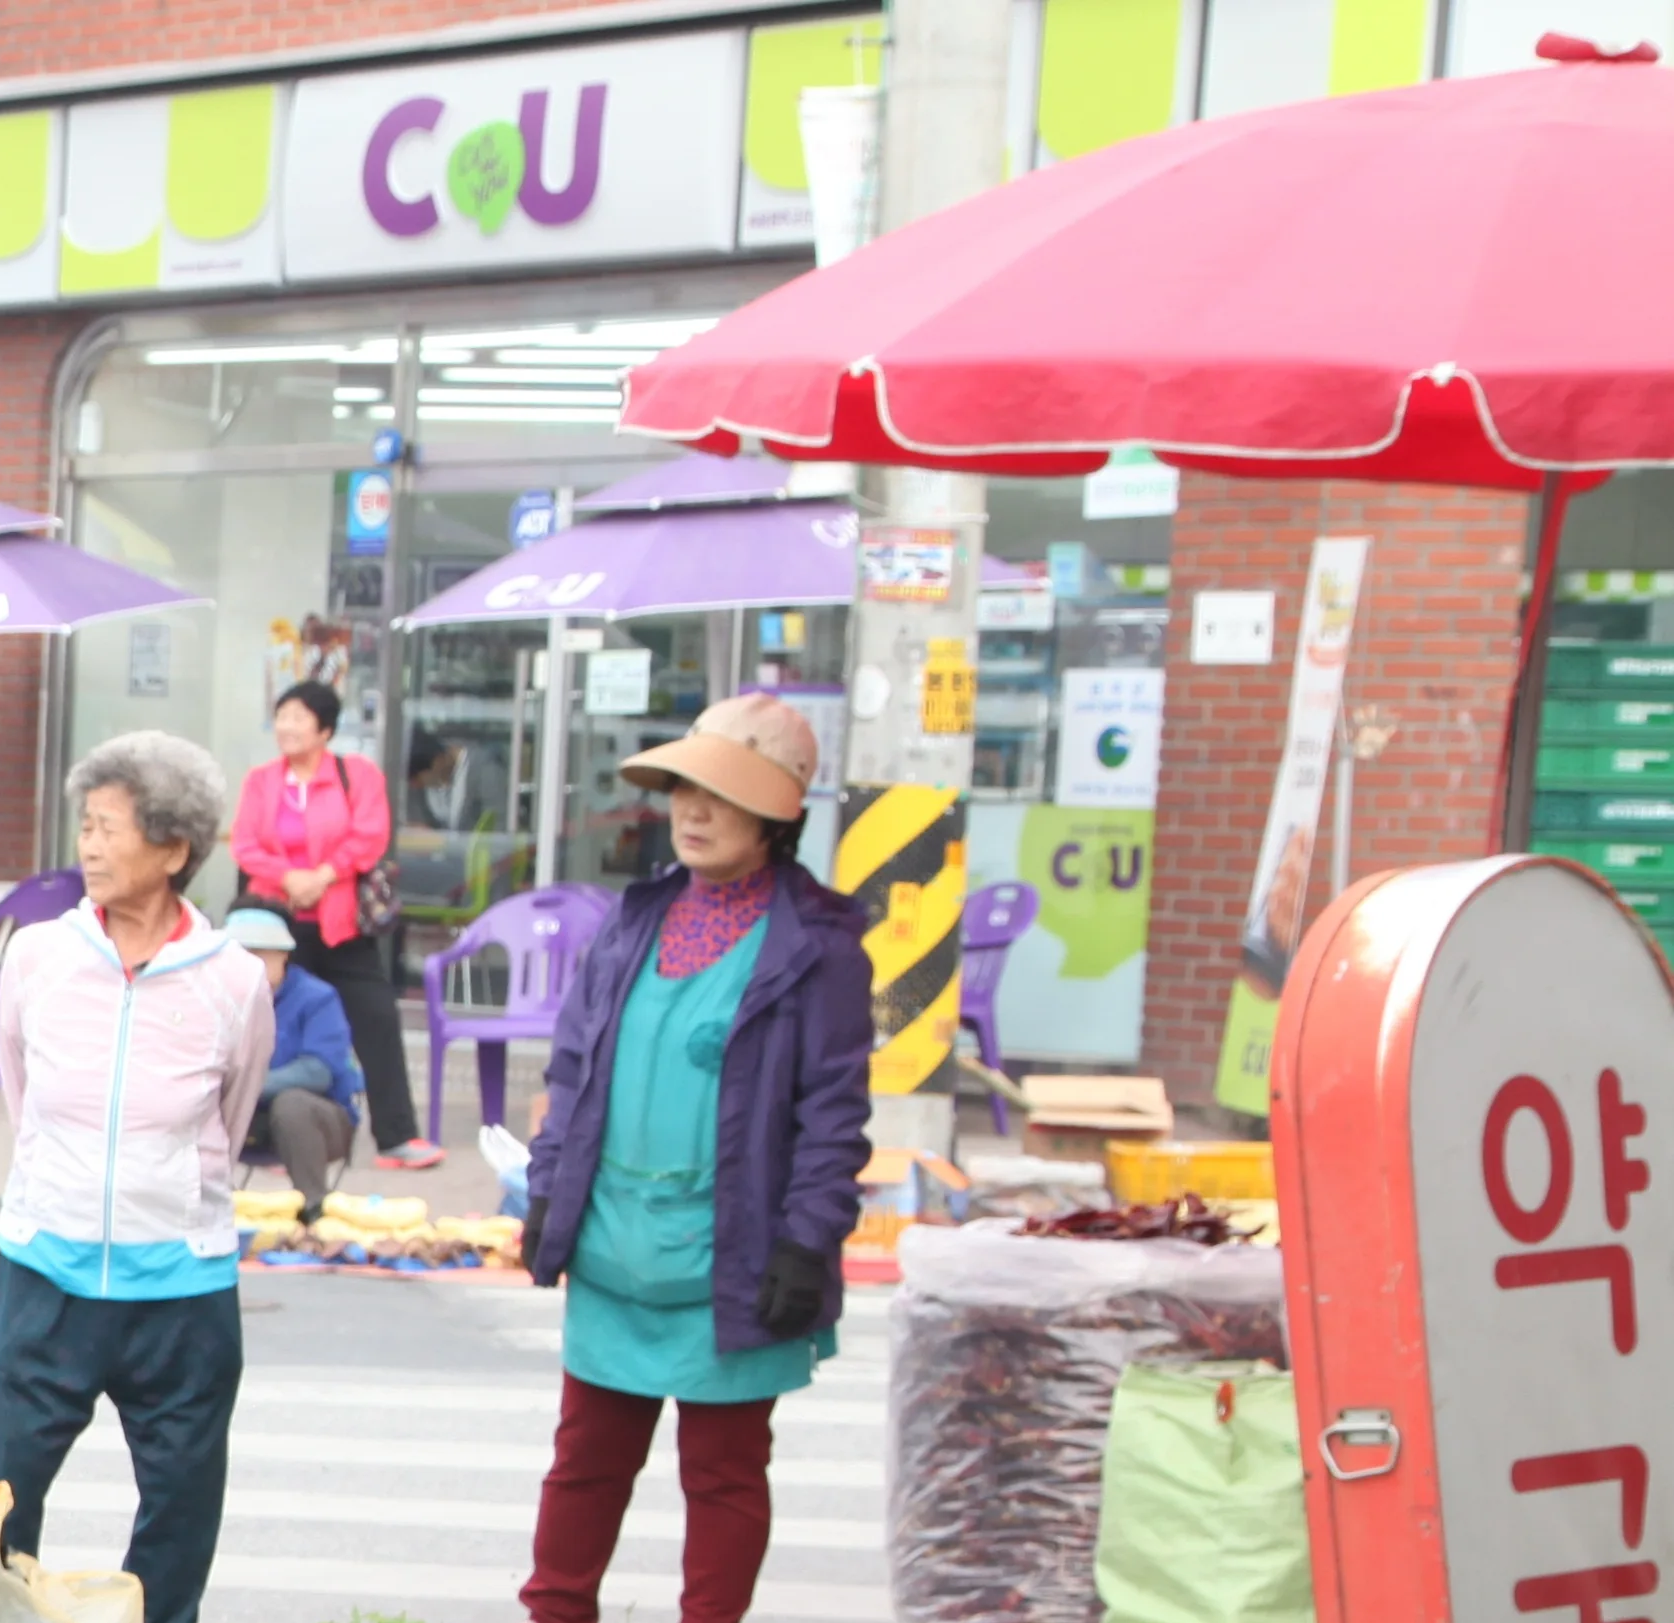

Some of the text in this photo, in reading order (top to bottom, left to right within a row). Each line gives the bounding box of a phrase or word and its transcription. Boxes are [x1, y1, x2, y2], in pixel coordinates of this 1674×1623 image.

[362, 83, 608, 238] CU
[484, 571, 607, 610] CU
[1051, 840, 1144, 891] CU
